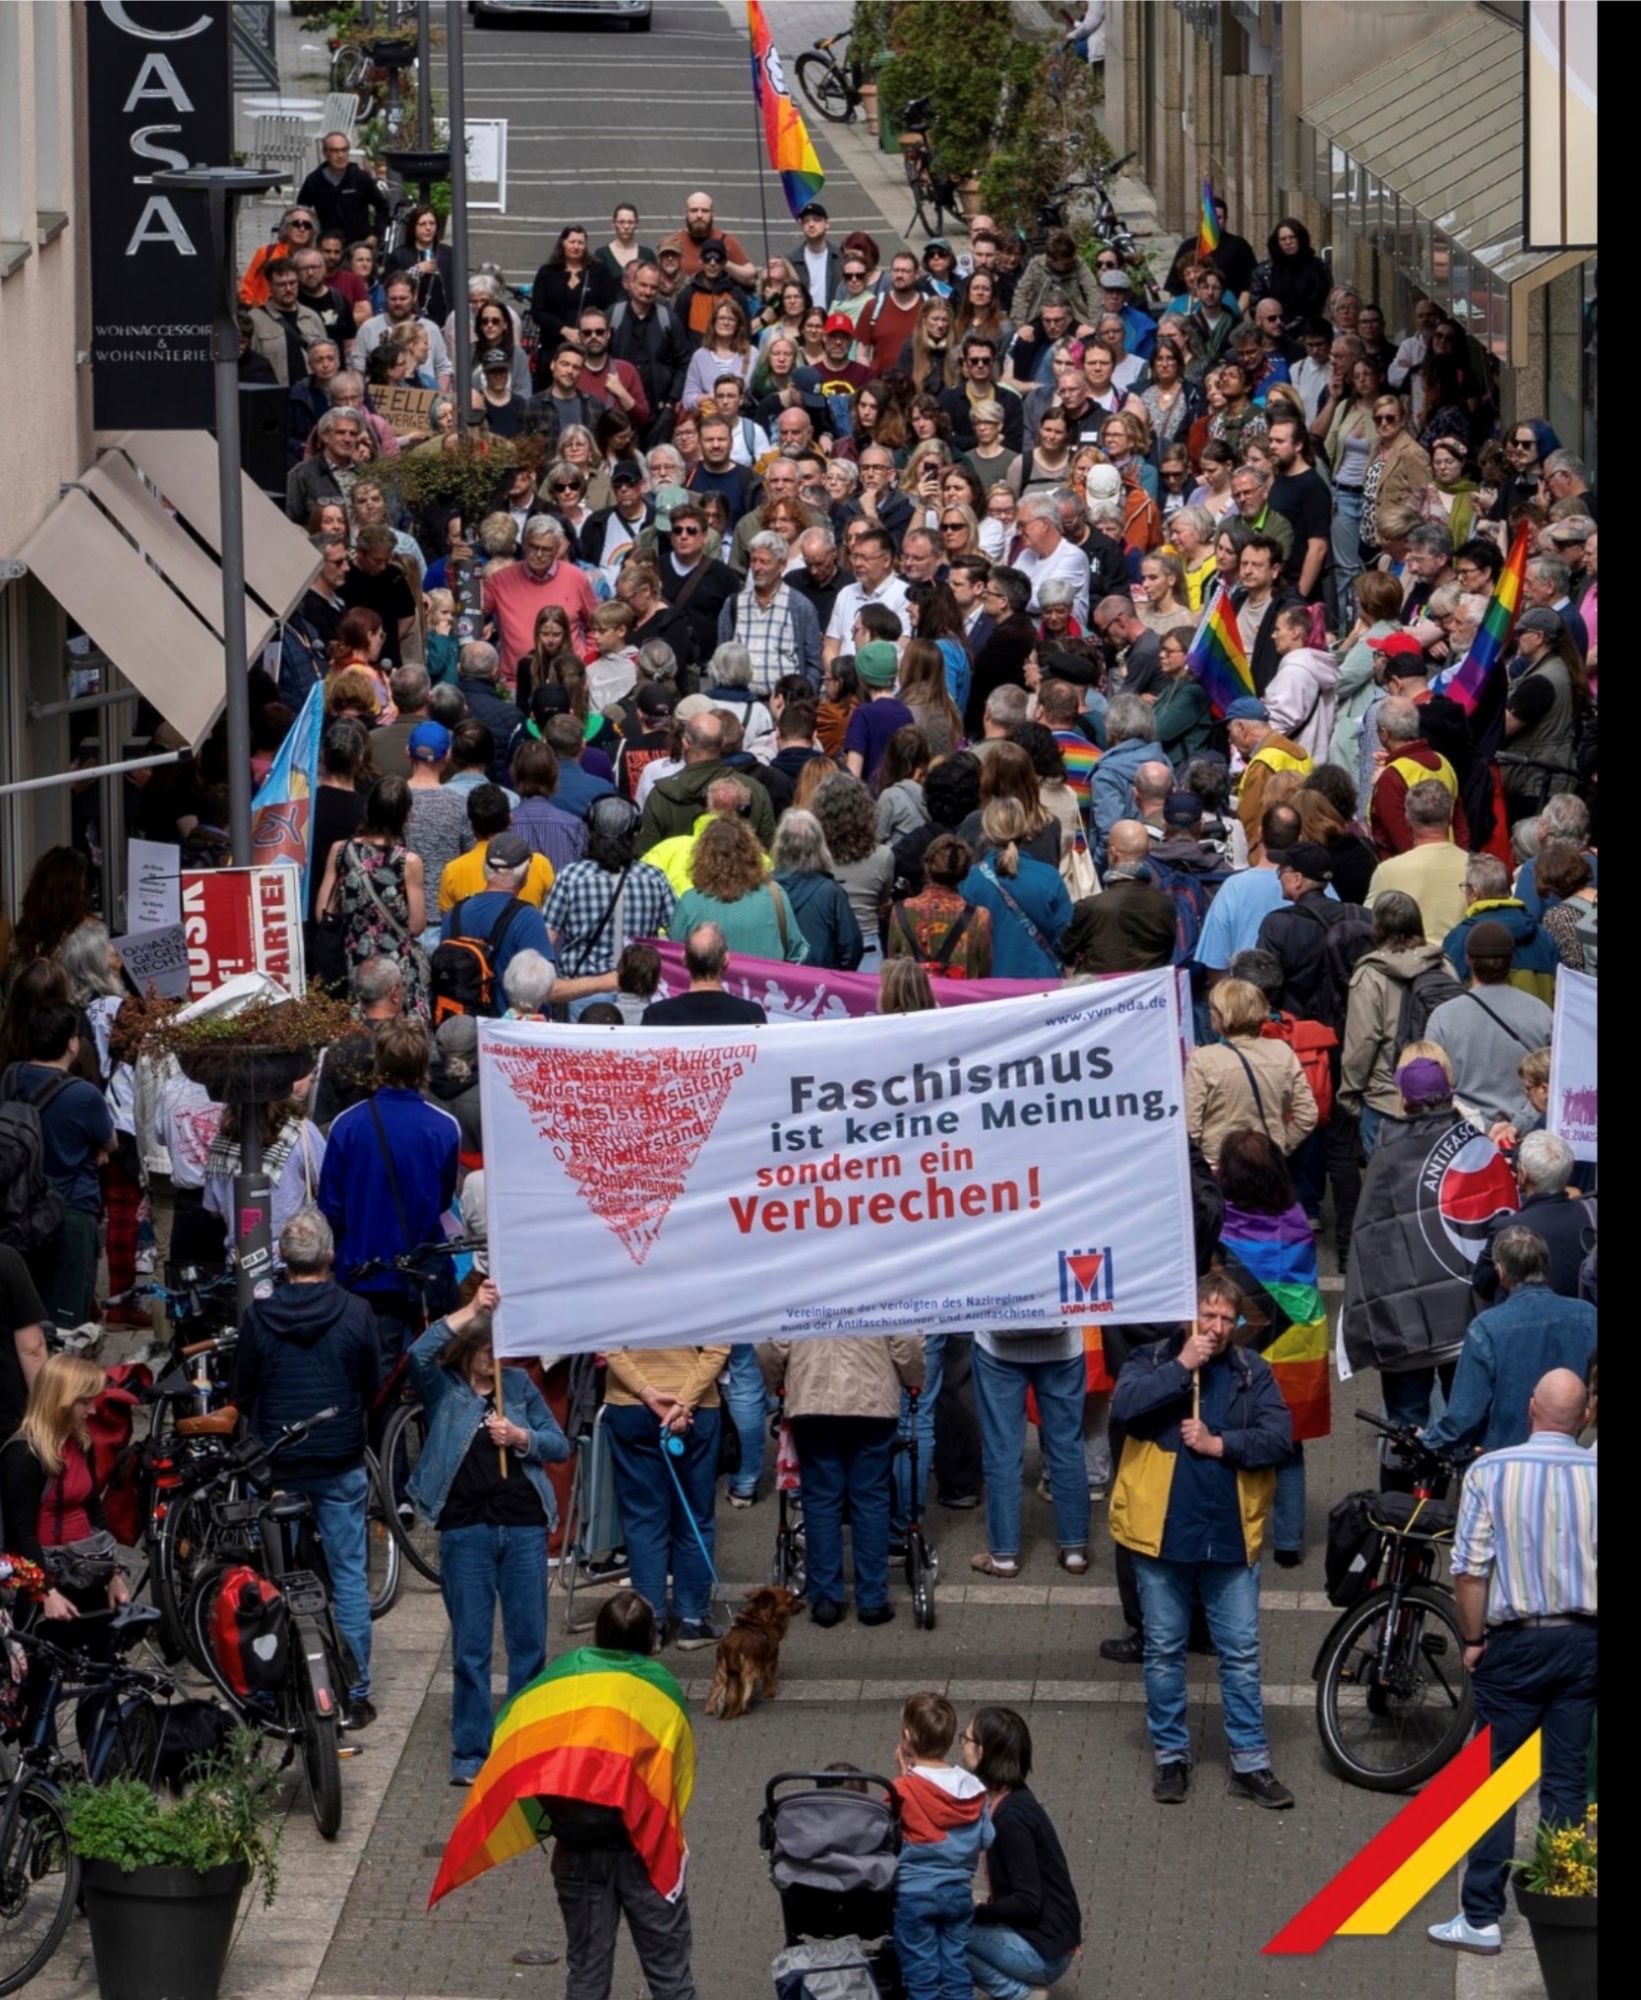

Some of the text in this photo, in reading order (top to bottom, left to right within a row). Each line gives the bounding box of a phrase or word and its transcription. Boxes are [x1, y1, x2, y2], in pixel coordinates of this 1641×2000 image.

[95, 324, 213, 336] WOHNACCESSOIR
[156, 337, 167, 349] &
[95, 350, 213, 361] WOHNINTERIE
[370, 387, 439, 414] #ELL
[183, 880, 213, 994] USK
[790, 1045, 1114, 1114] Faschismus
[771, 1090, 1180, 1153] ist keine Meinung,
[756, 1141, 975, 1189] sondern ein
[1423, 1120, 1482, 1193] ANTIFASC
[728, 1166, 1042, 1235] Verbrechen!
[786, 1305, 854, 1319] Vereinigung
[942, 1296, 962, 1308] des
[813, 1319, 833, 1330] der
